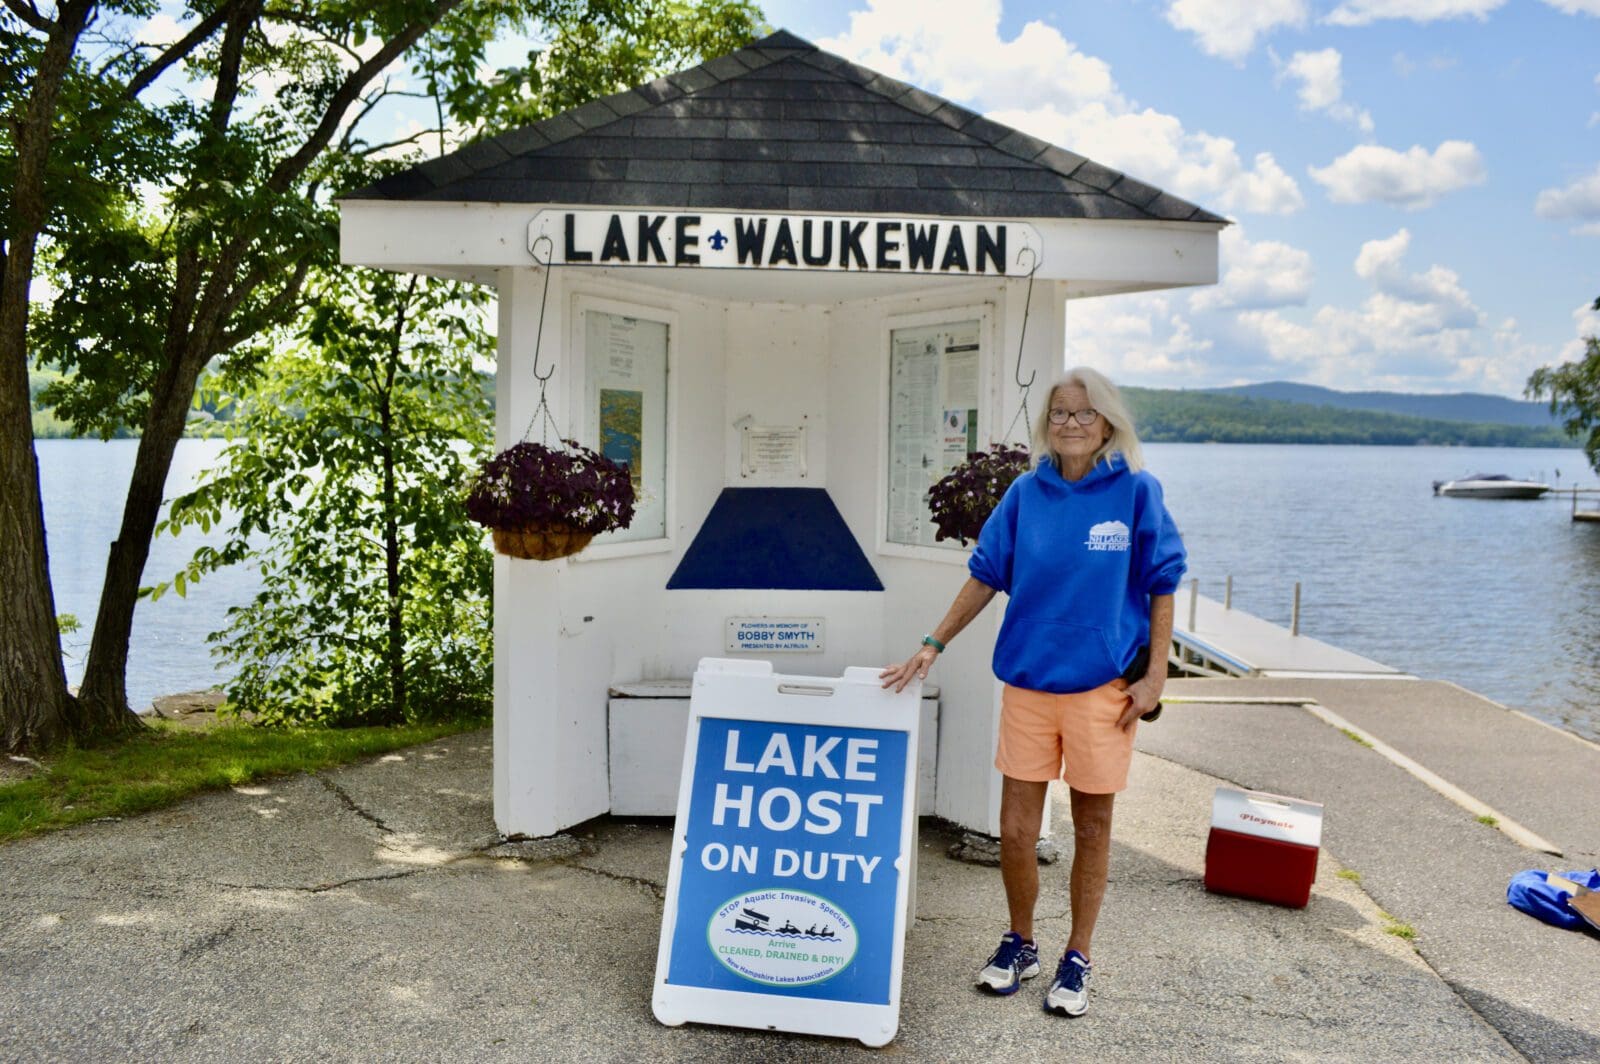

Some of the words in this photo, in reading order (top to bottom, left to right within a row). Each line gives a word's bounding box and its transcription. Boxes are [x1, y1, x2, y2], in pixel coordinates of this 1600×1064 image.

[564, 213, 701, 266] LAKE
[734, 217, 1007, 275] WAUKEWAN
[737, 631, 775, 641] BOBBY
[777, 631, 815, 641] SMYTH
[724, 729, 879, 782] LAKE
[712, 783, 884, 838] HOST
[1240, 812, 1295, 830] Playmate
[701, 842, 758, 875] ON
[773, 848, 882, 884] DUTY
[719, 901, 740, 919] STOP
[744, 892, 777, 905] Aquatic
[780, 892, 817, 907] Invasive
[819, 902, 851, 930] Species!
[718, 946, 763, 959] CLEANED,
[766, 950, 809, 962] DRAINED
[811, 955, 819, 963] &
[821, 955, 845, 965] DRY!
[768, 939, 796, 949] Arrive
[726, 957, 740, 970] New
[740, 965, 775, 982] Hampshire
[775, 975, 795, 983] Lakes
[796, 967, 834, 982] Association
